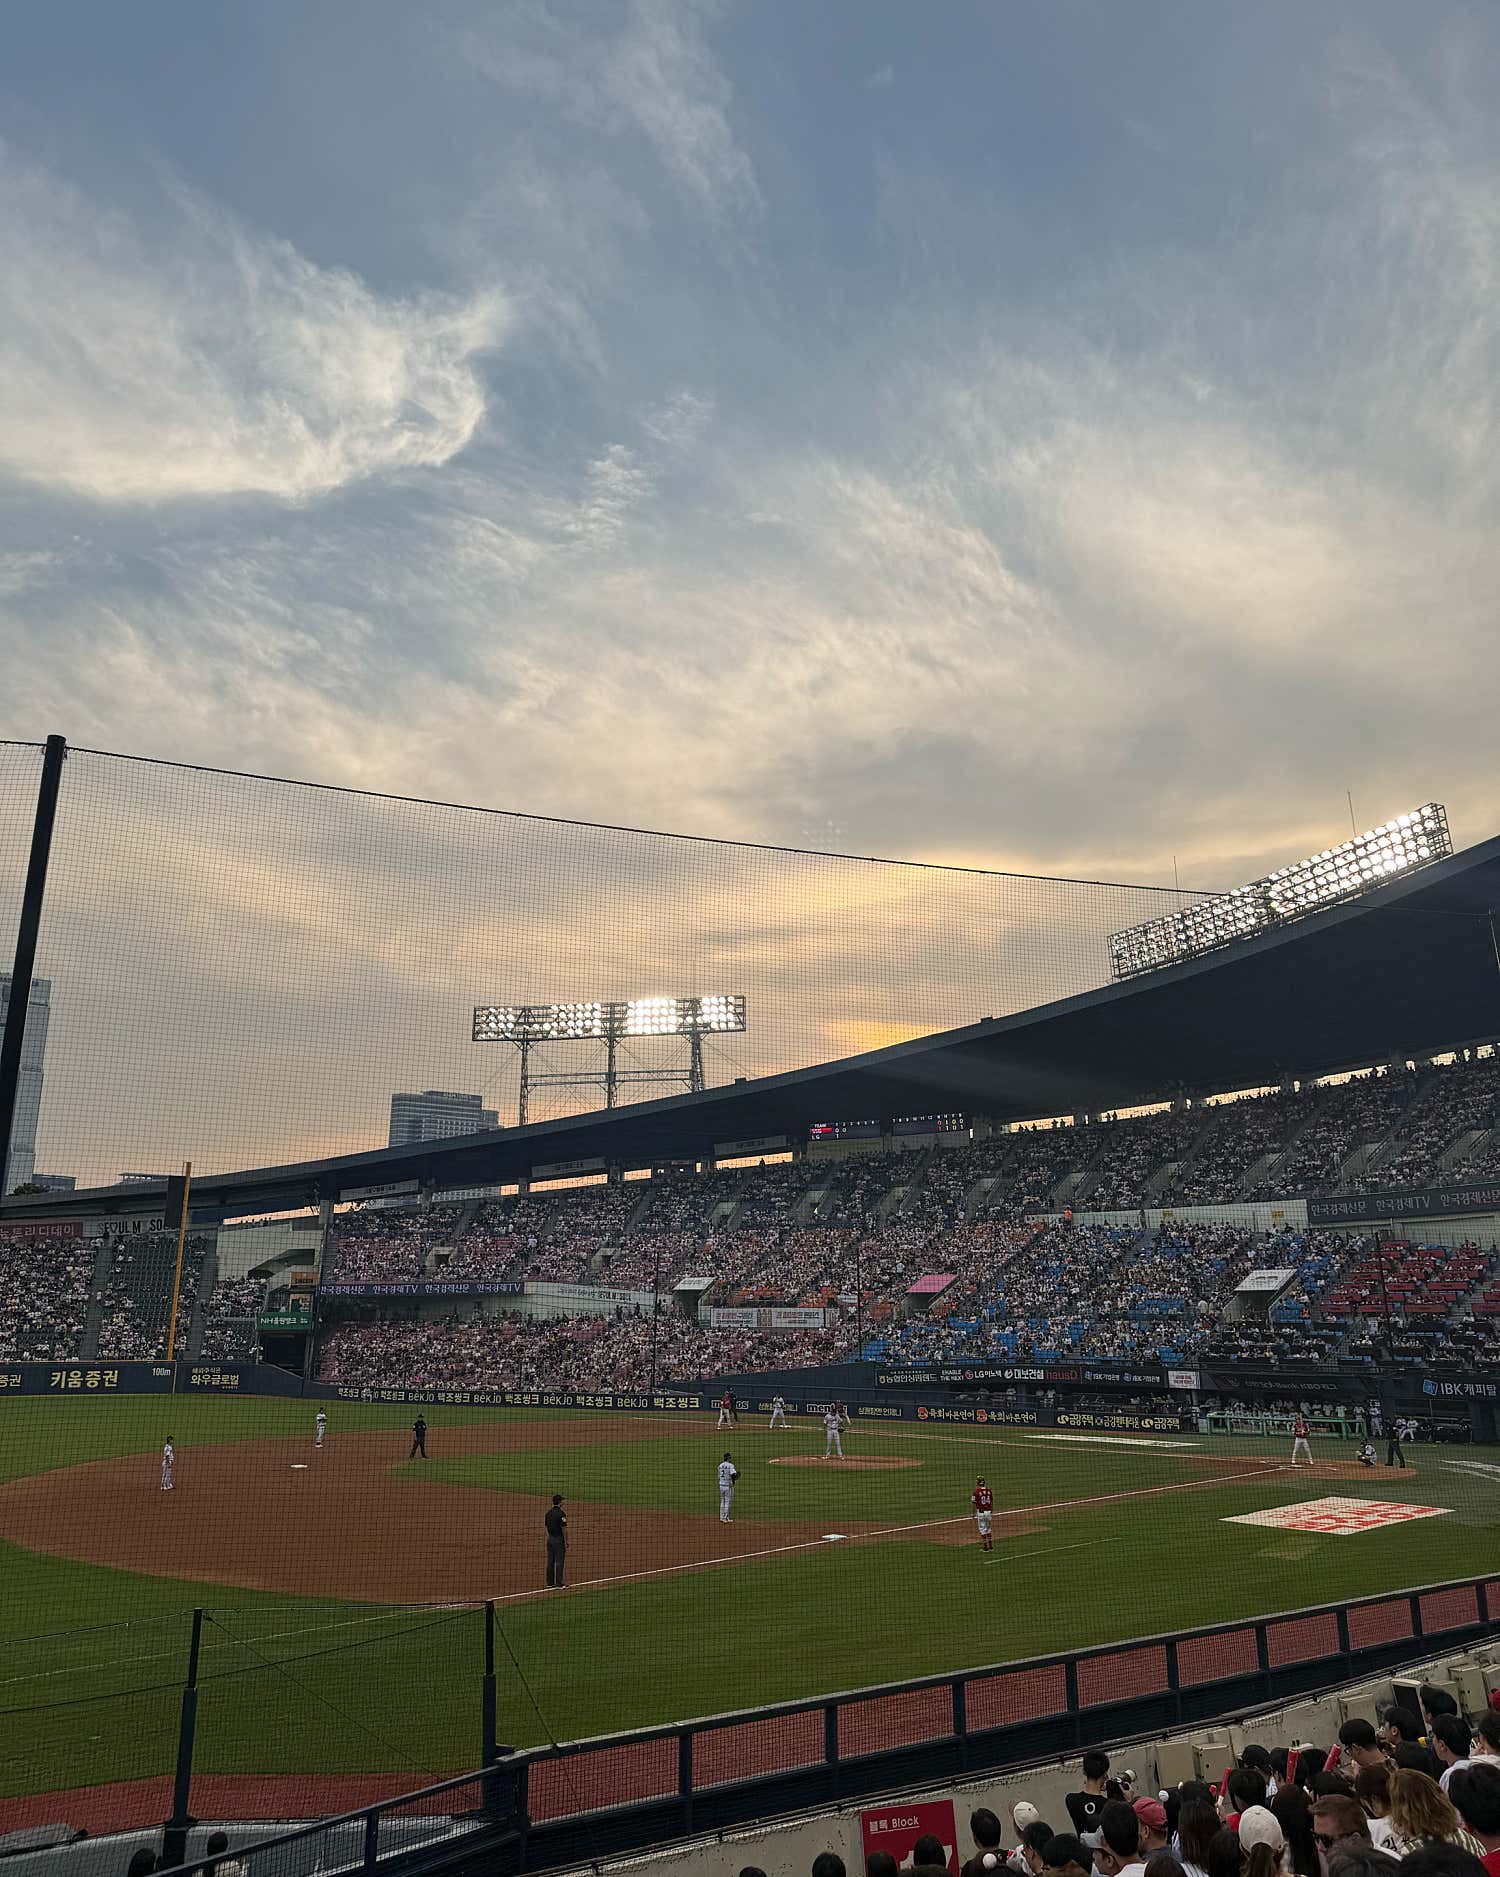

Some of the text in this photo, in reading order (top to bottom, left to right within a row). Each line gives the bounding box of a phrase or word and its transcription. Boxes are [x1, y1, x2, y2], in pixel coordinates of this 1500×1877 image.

[50, 1370, 119, 1389] 키움증권
[1013, 1369, 1044, 1379] 대보건설
[380, 1391, 405, 1401] 백조씽크
[437, 1392, 470, 1402] 백조씽크
[505, 1394, 539, 1404] 백조씽크
[576, 1395, 613, 1407] 백조씽크
[653, 1397, 700, 1408] 백조씽크
[891, 1815, 920, 1829] Block
